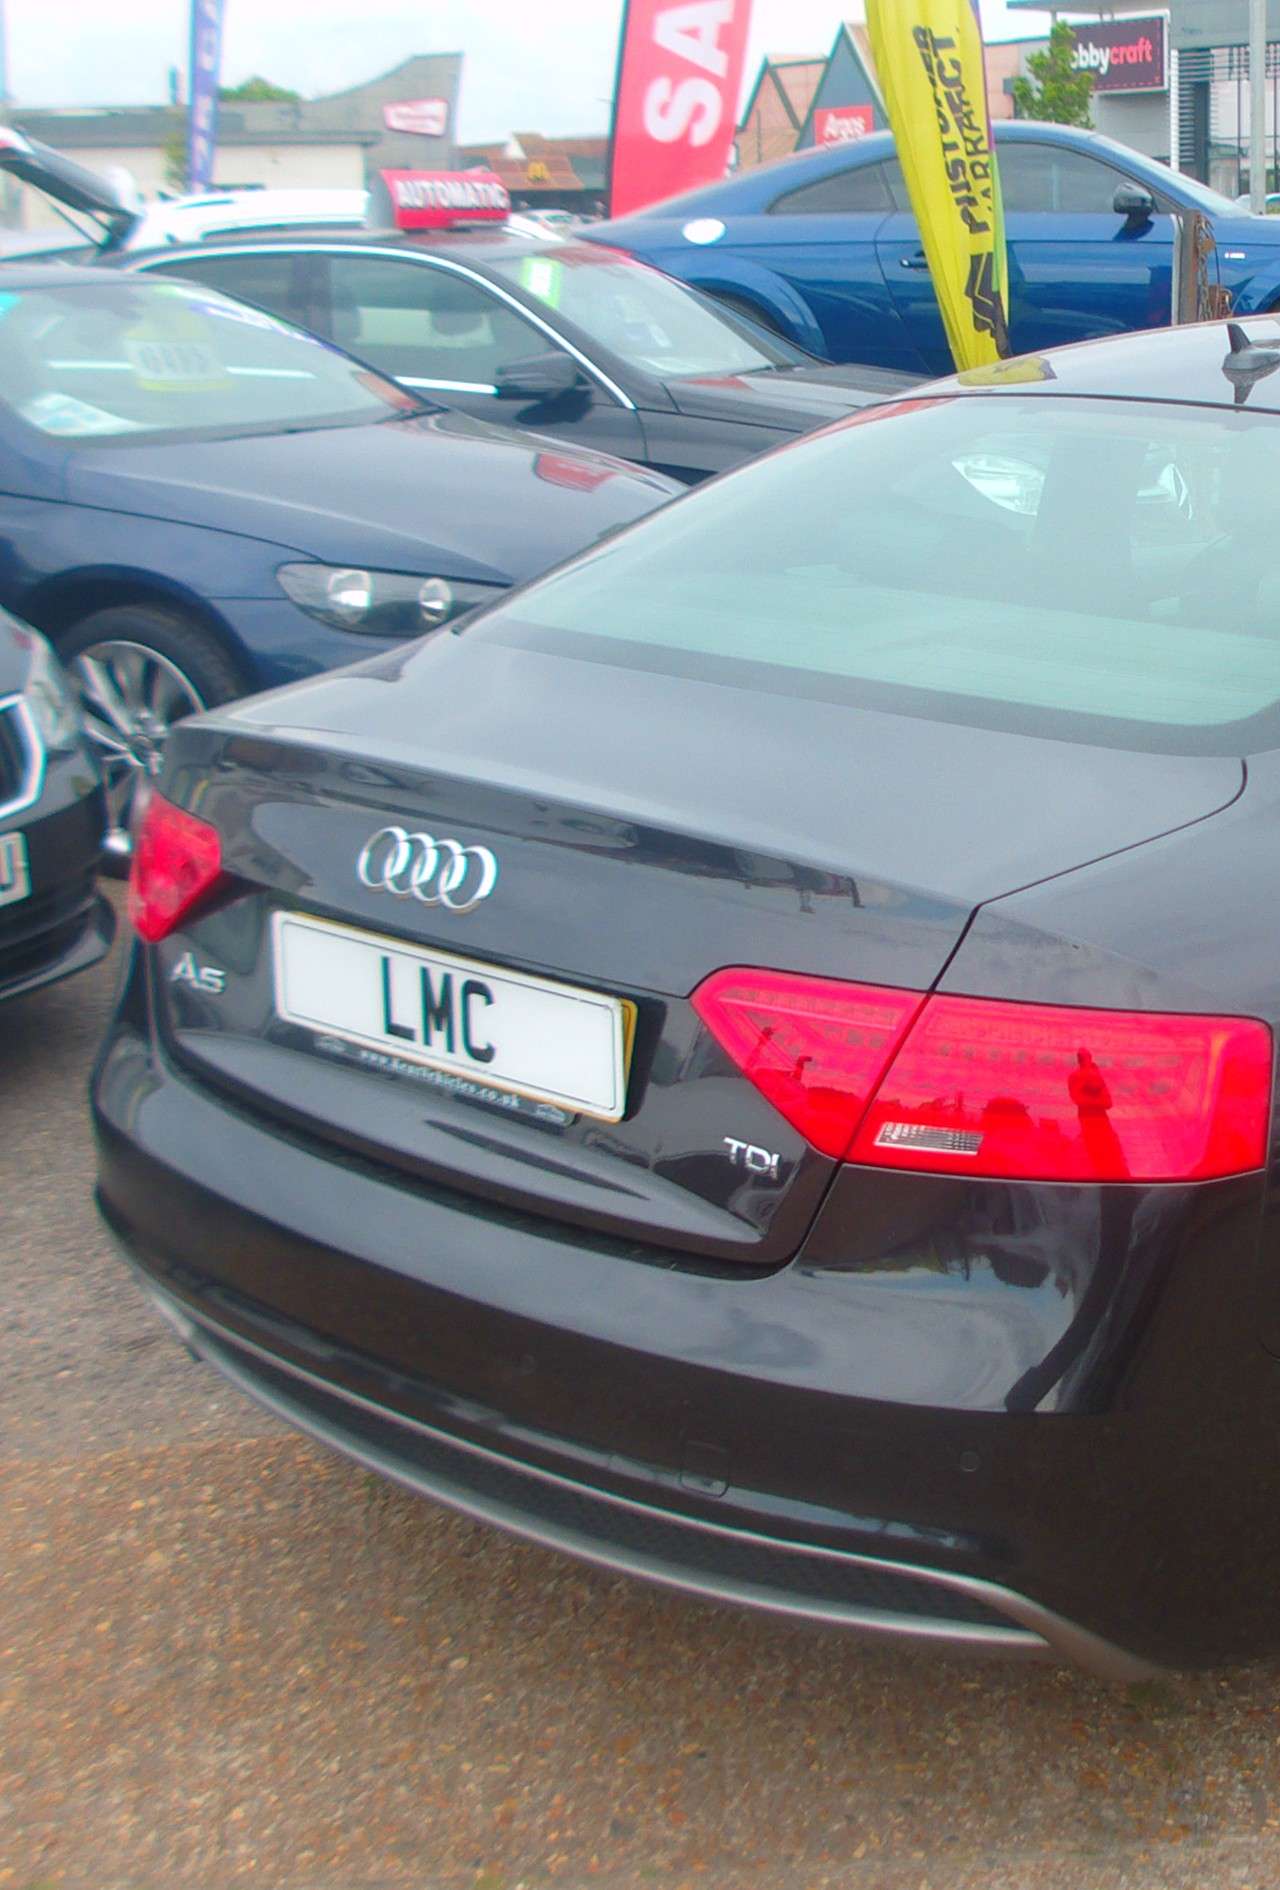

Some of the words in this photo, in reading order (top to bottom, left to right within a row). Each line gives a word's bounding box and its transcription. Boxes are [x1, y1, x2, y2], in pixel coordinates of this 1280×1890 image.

[392, 180, 511, 208] AUTOMATIC
[171, 952, 226, 993] A5
[381, 956, 497, 1063] LMC
[723, 1137, 780, 1180] TDI
